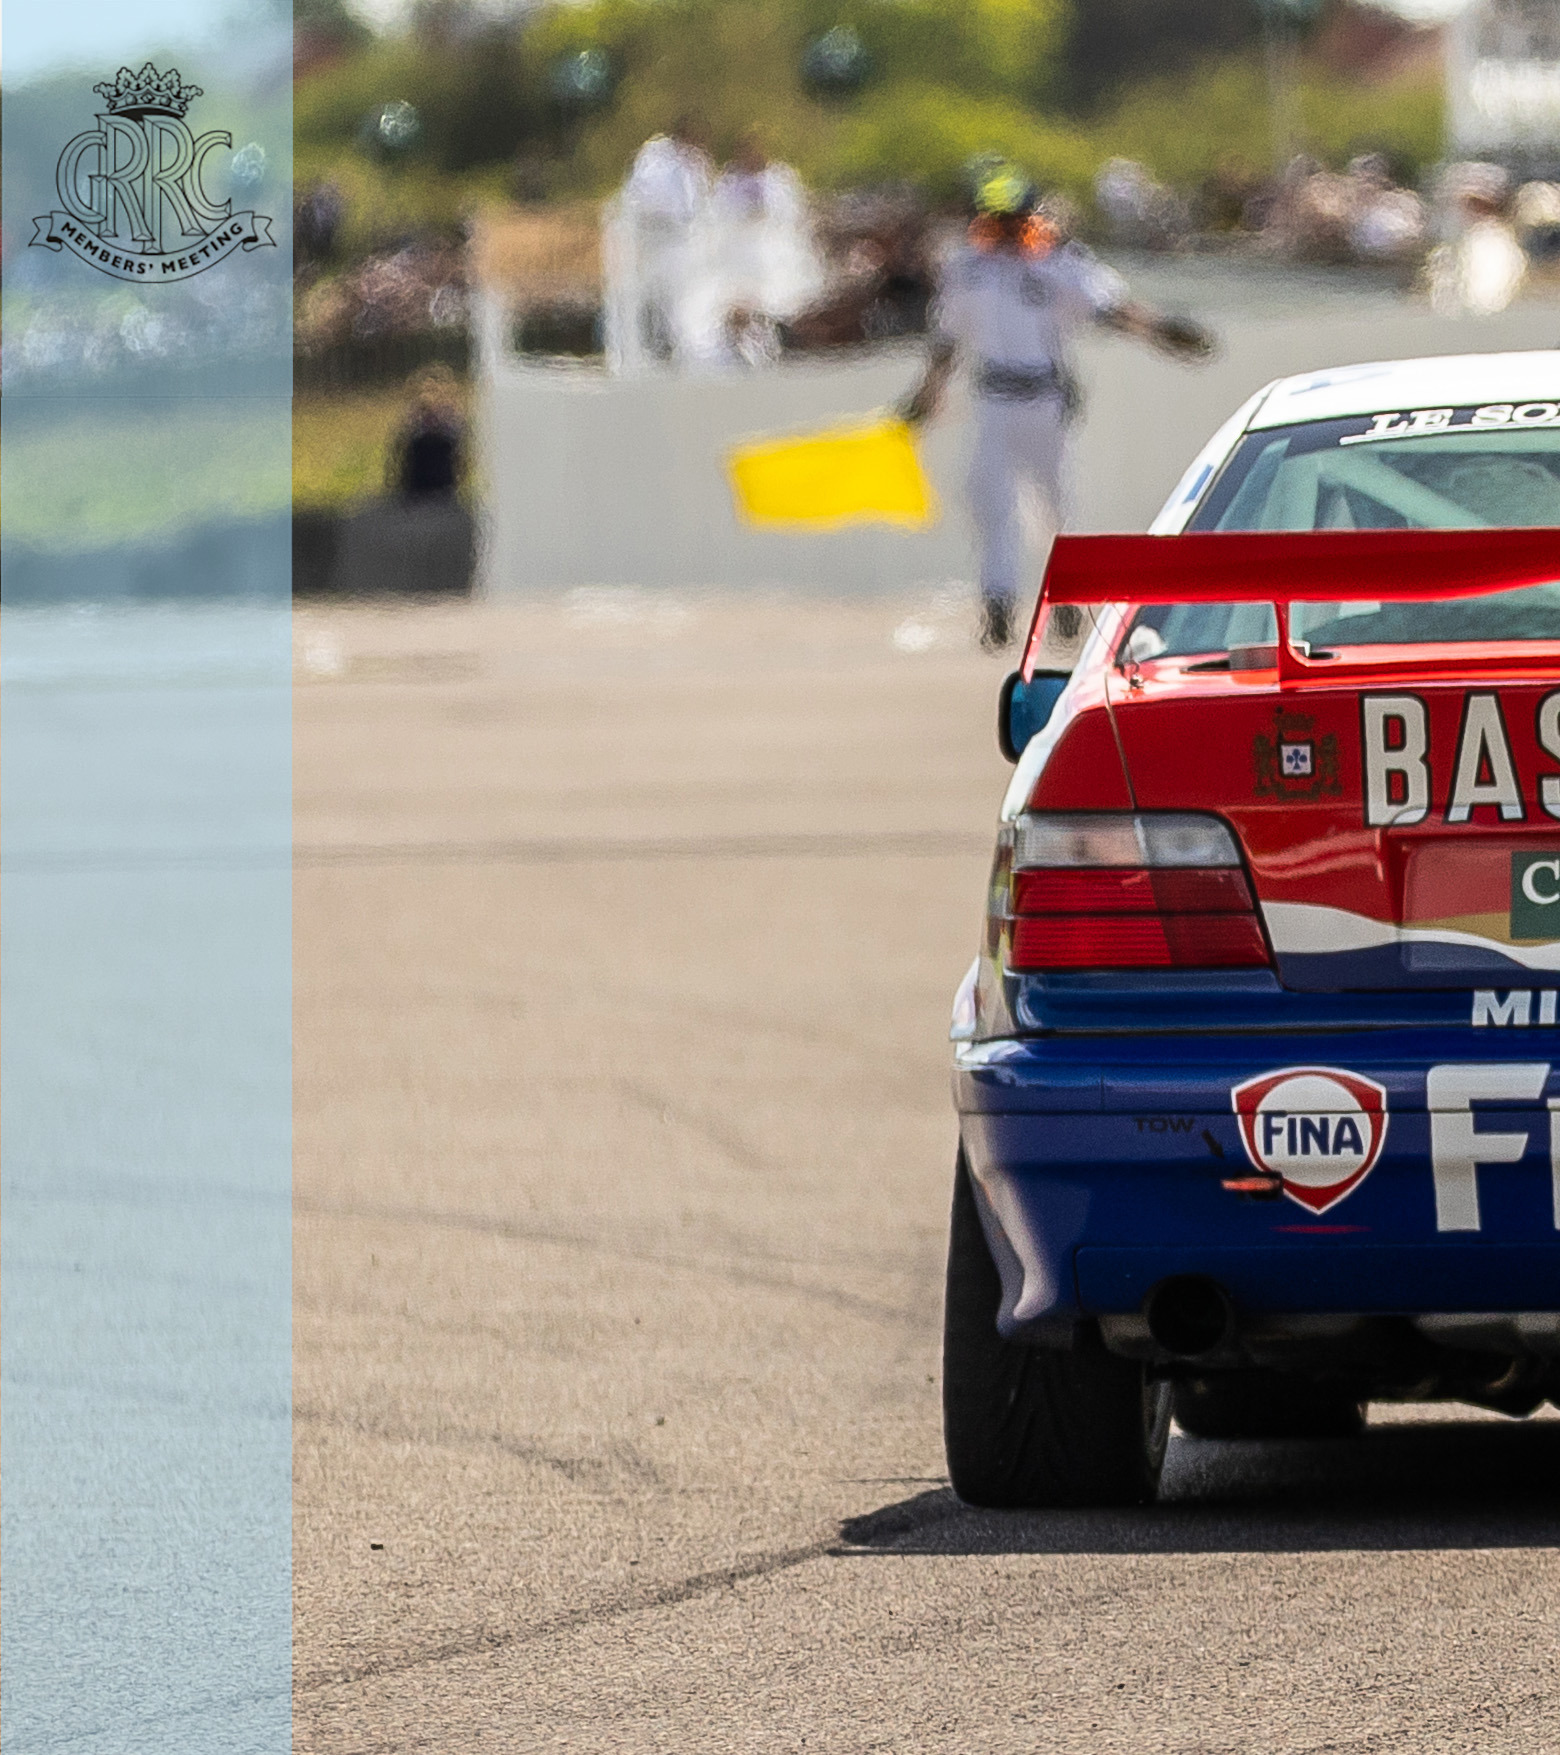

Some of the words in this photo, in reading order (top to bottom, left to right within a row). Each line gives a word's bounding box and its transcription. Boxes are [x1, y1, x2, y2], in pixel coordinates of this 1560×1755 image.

[1366, 408, 1454, 434] LE
[1134, 1116, 1195, 1134] TOW
[1262, 1109, 1364, 1156] FINA
